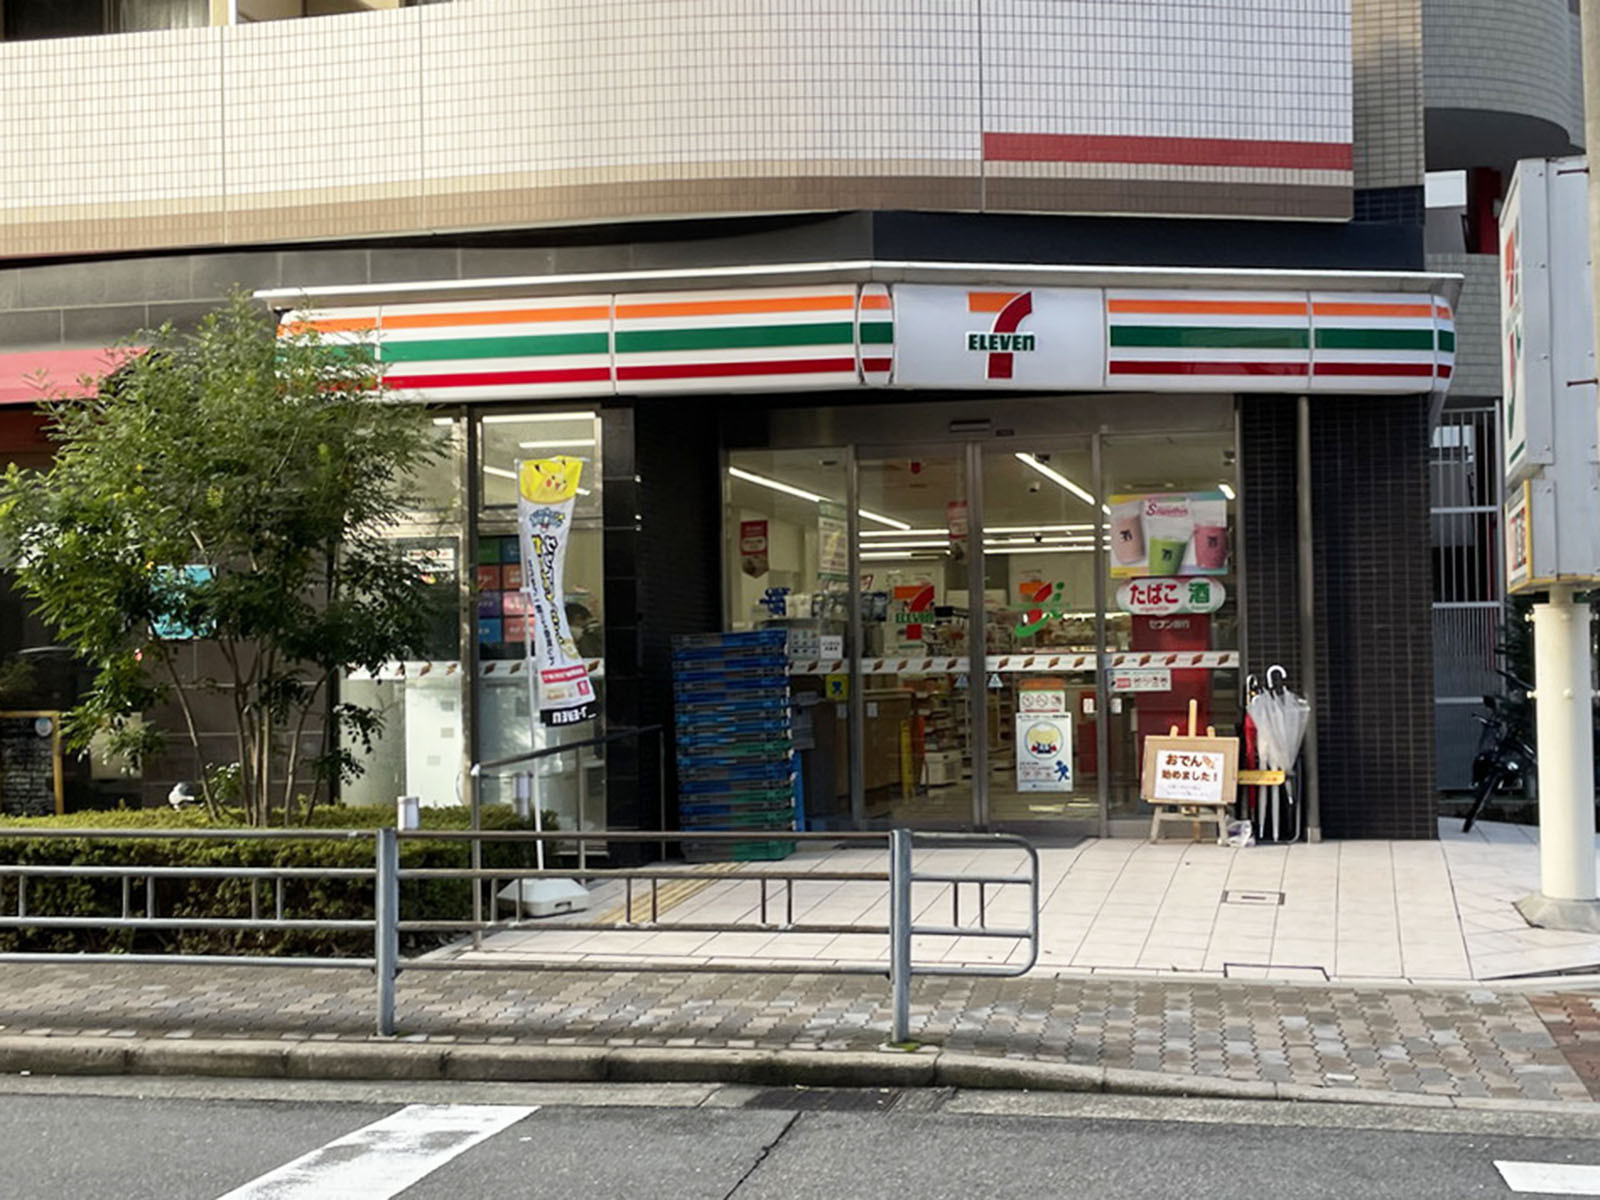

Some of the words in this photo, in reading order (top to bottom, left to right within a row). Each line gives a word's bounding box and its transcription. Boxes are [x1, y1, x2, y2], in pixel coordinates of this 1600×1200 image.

[968, 291, 1032, 379] 7
[1130, 583, 1179, 605] たばこ
[1188, 582, 1210, 604] 酒
[1165, 754, 1202, 767] おでん
[1162, 769, 1218, 782] 始めました！
